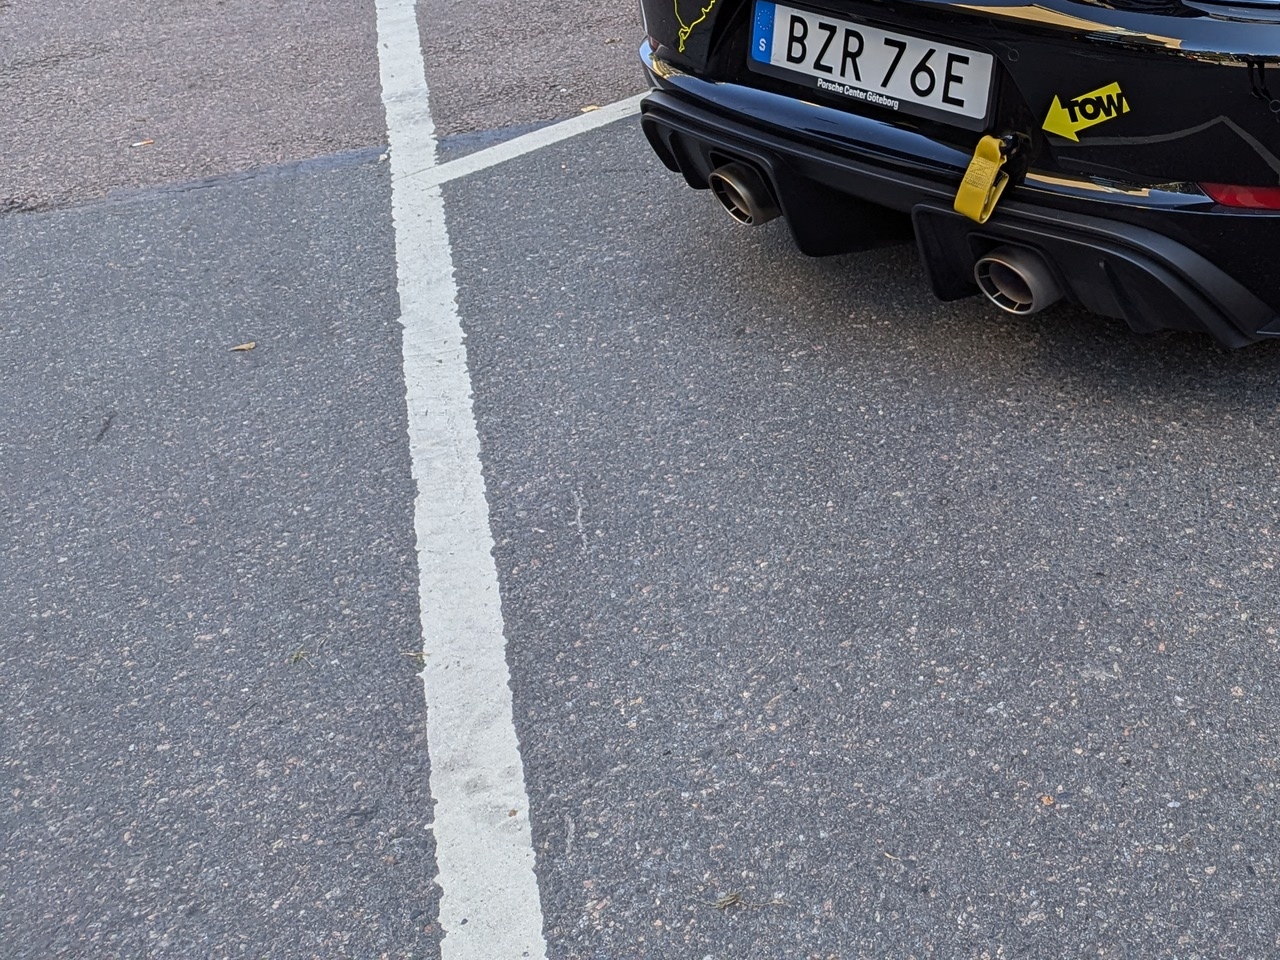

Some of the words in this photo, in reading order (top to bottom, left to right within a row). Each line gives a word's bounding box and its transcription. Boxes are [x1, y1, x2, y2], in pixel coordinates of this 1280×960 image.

[758, 38, 767, 52] S
[786, 14, 865, 82] BZR
[880, 37, 970, 108] 76E
[817, 78, 844, 94] Porsche
[844, 85, 867, 100] Center
[866, 91, 899, 110] Göteborg
[1061, 92, 1124, 123] TOW
